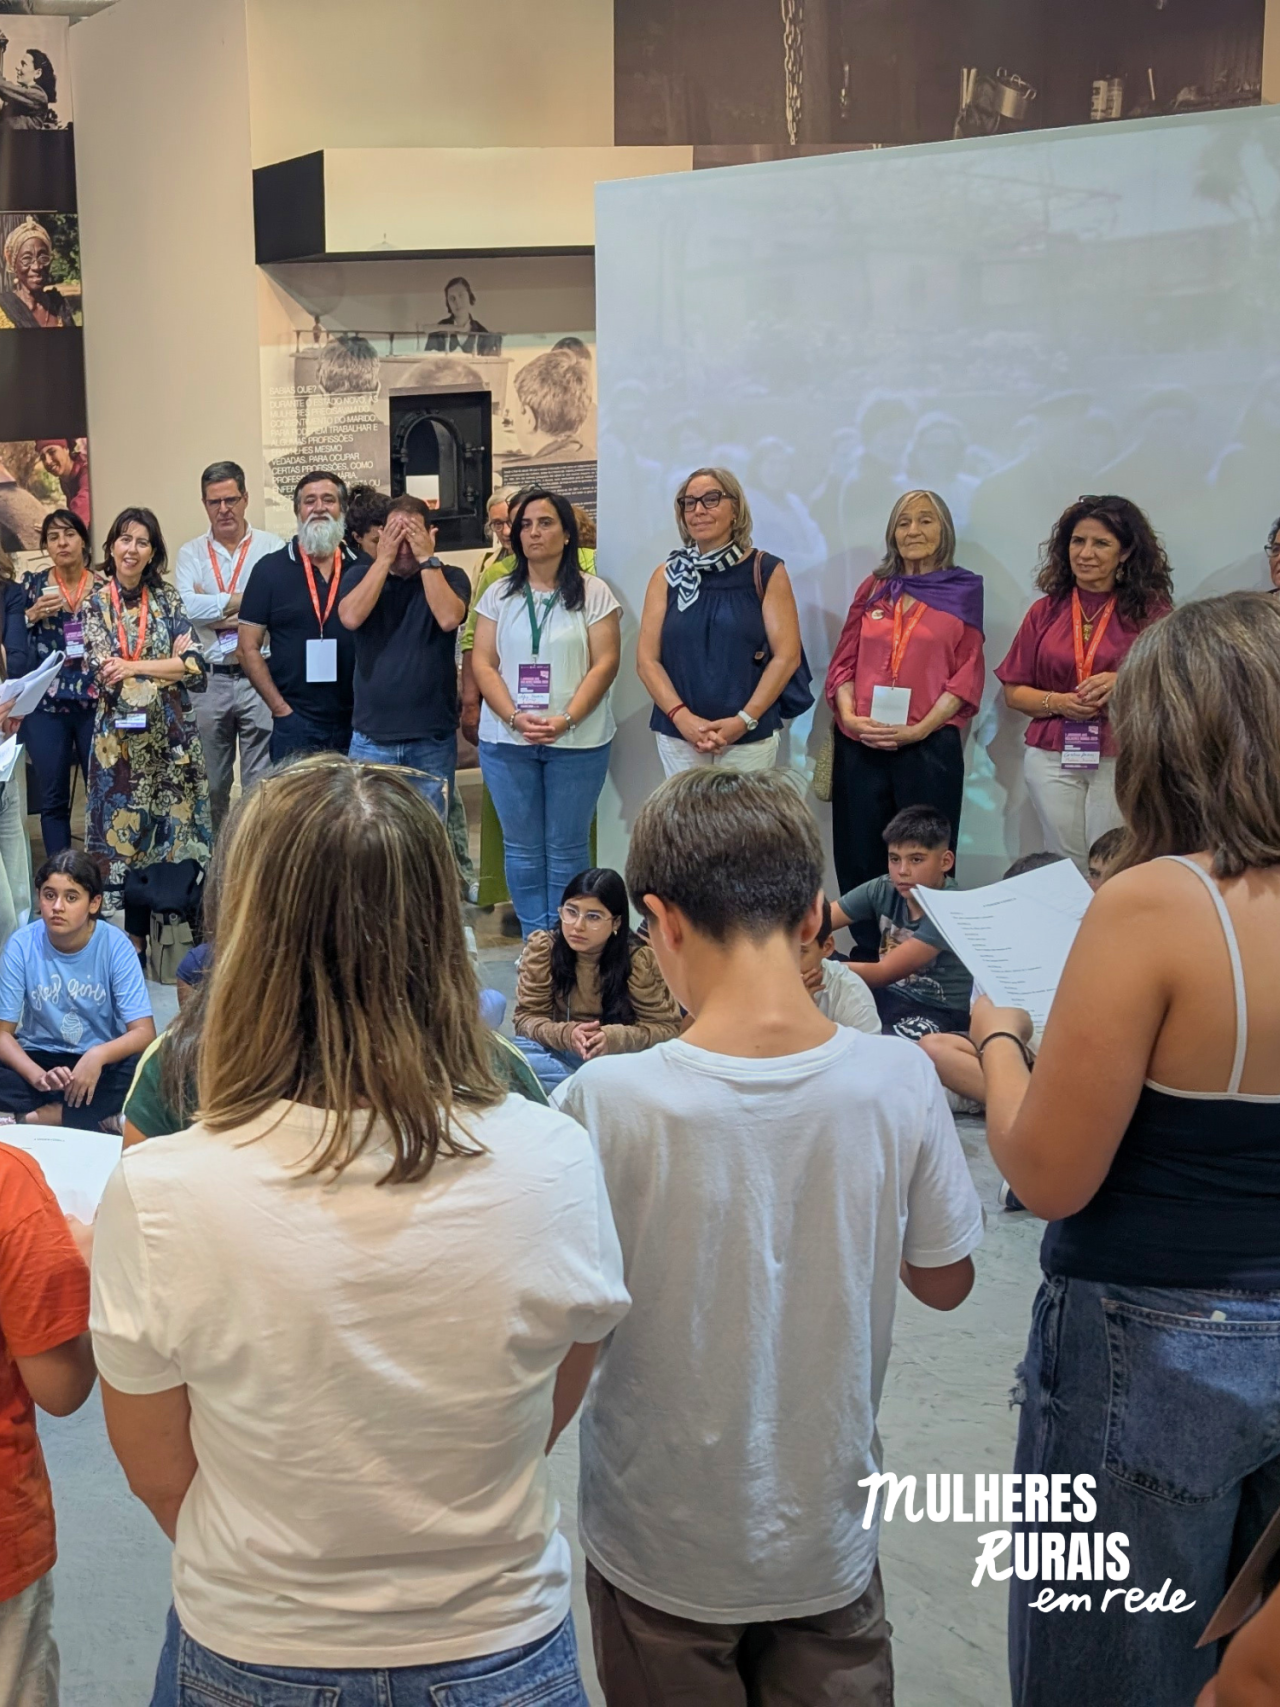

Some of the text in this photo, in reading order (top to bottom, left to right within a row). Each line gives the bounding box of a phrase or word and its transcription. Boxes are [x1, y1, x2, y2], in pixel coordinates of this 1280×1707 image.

[270, 386, 317, 395] SABIAS QUE?
[347, 414, 376, 422] MARIDO
[329, 425, 371, 433] TRABALHAR
[308, 434, 353, 444] PROFISSÕES
[315, 444, 342, 453] MESMO
[309, 454, 328, 462] PARA
[330, 452, 360, 462] OCUPAR
[272, 464, 300, 475] CERTAS
[350, 461, 373, 469] COMO
